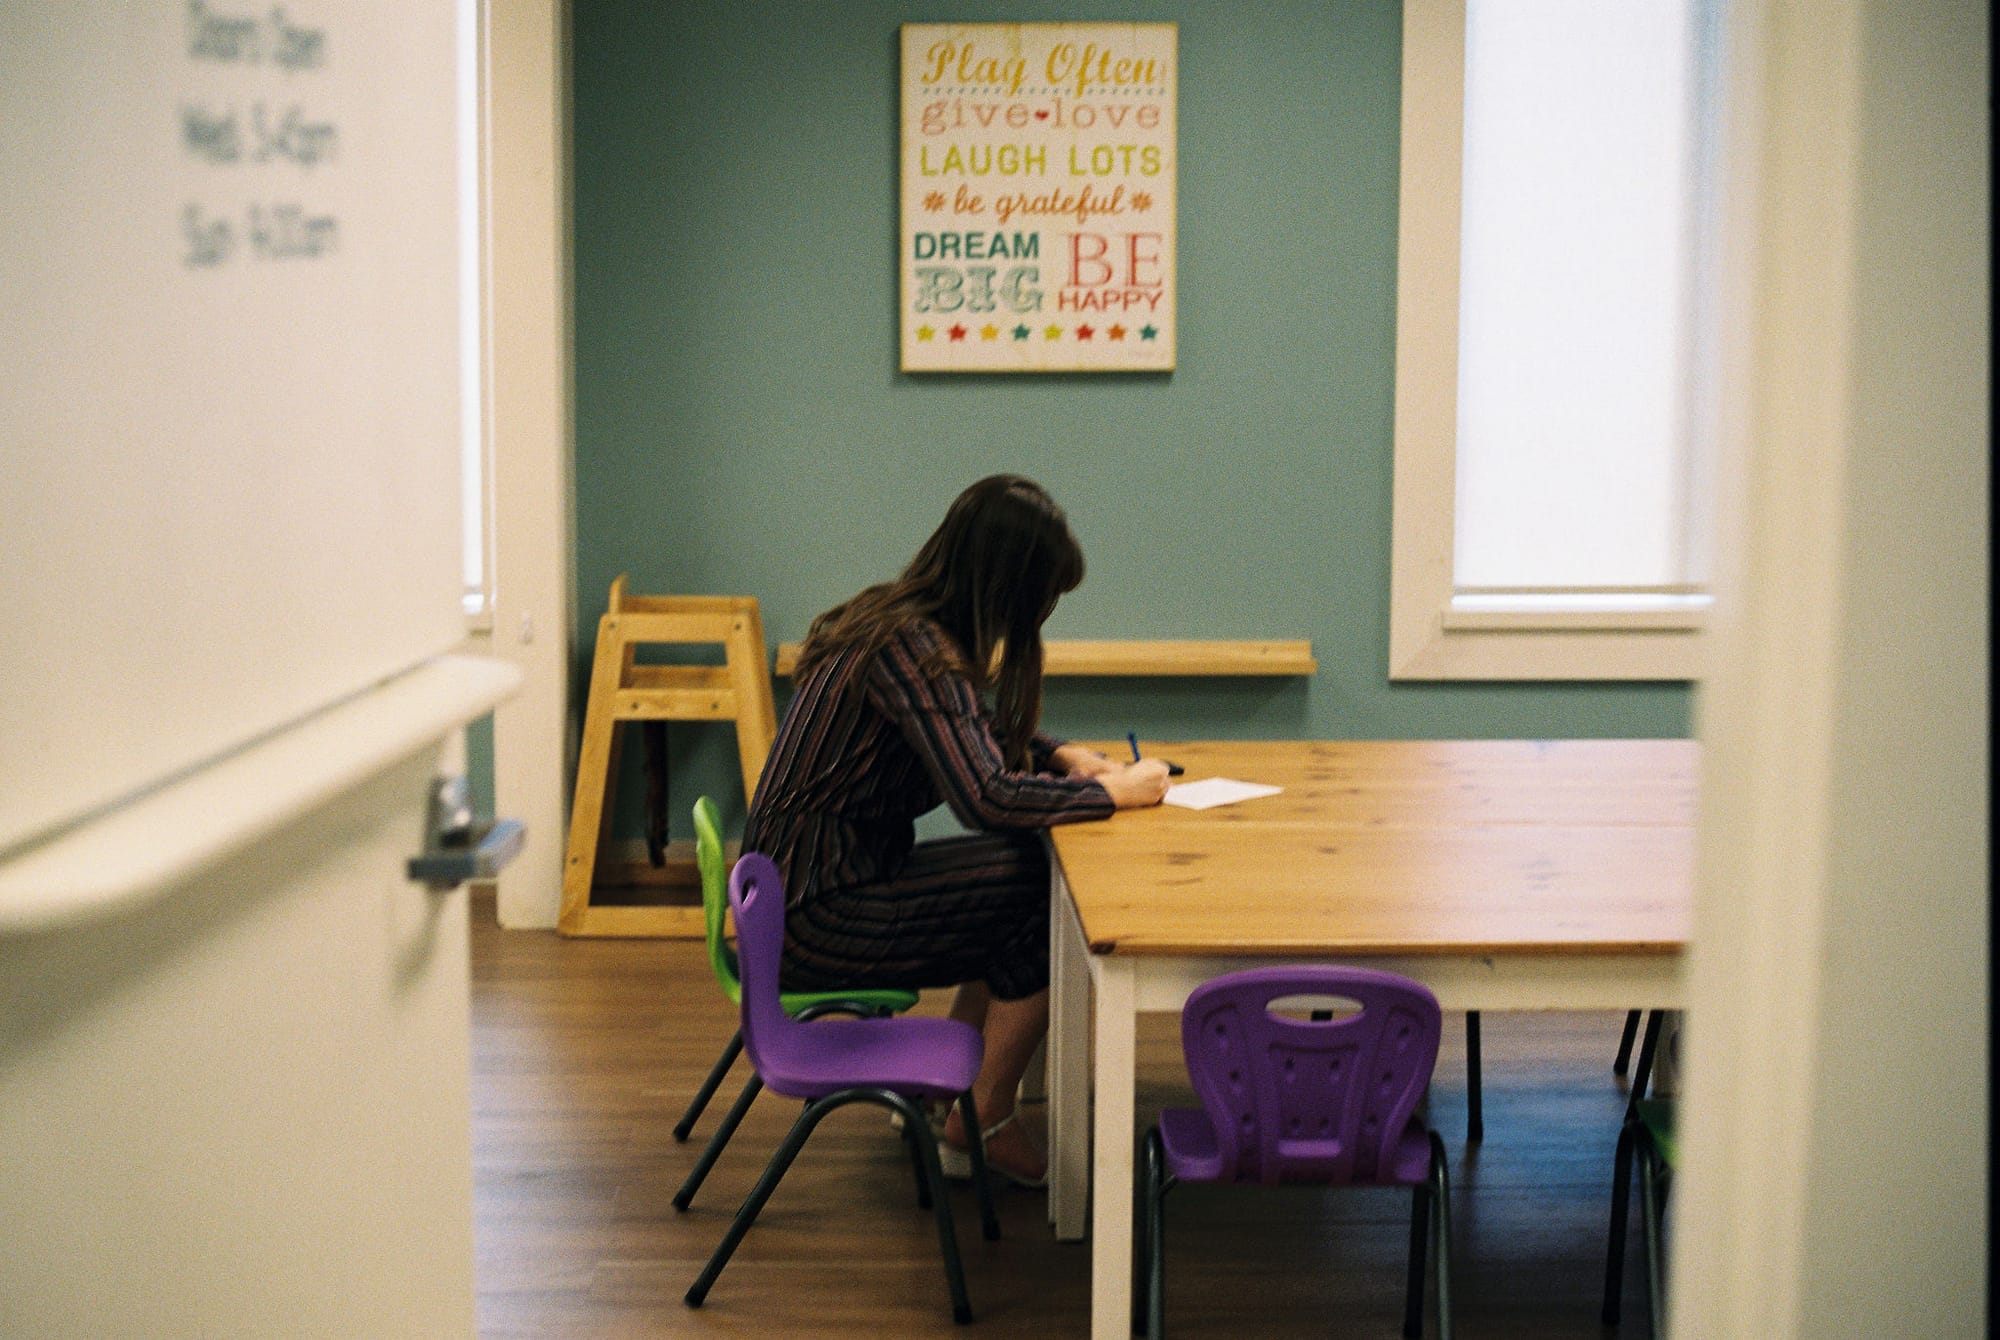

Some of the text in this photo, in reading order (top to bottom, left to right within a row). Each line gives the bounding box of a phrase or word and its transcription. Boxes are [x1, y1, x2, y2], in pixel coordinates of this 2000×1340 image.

[921, 39, 1168, 97] Play Often
[920, 96, 1160, 136] give love
[920, 144, 1162, 177] LAUGH LOTS
[952, 183, 1125, 225] be grateful
[914, 231, 1040, 260] DREAM
[1060, 231, 1163, 288] BE
[914, 265, 1044, 314] BIG
[1057, 289, 1164, 313] HAPPY
